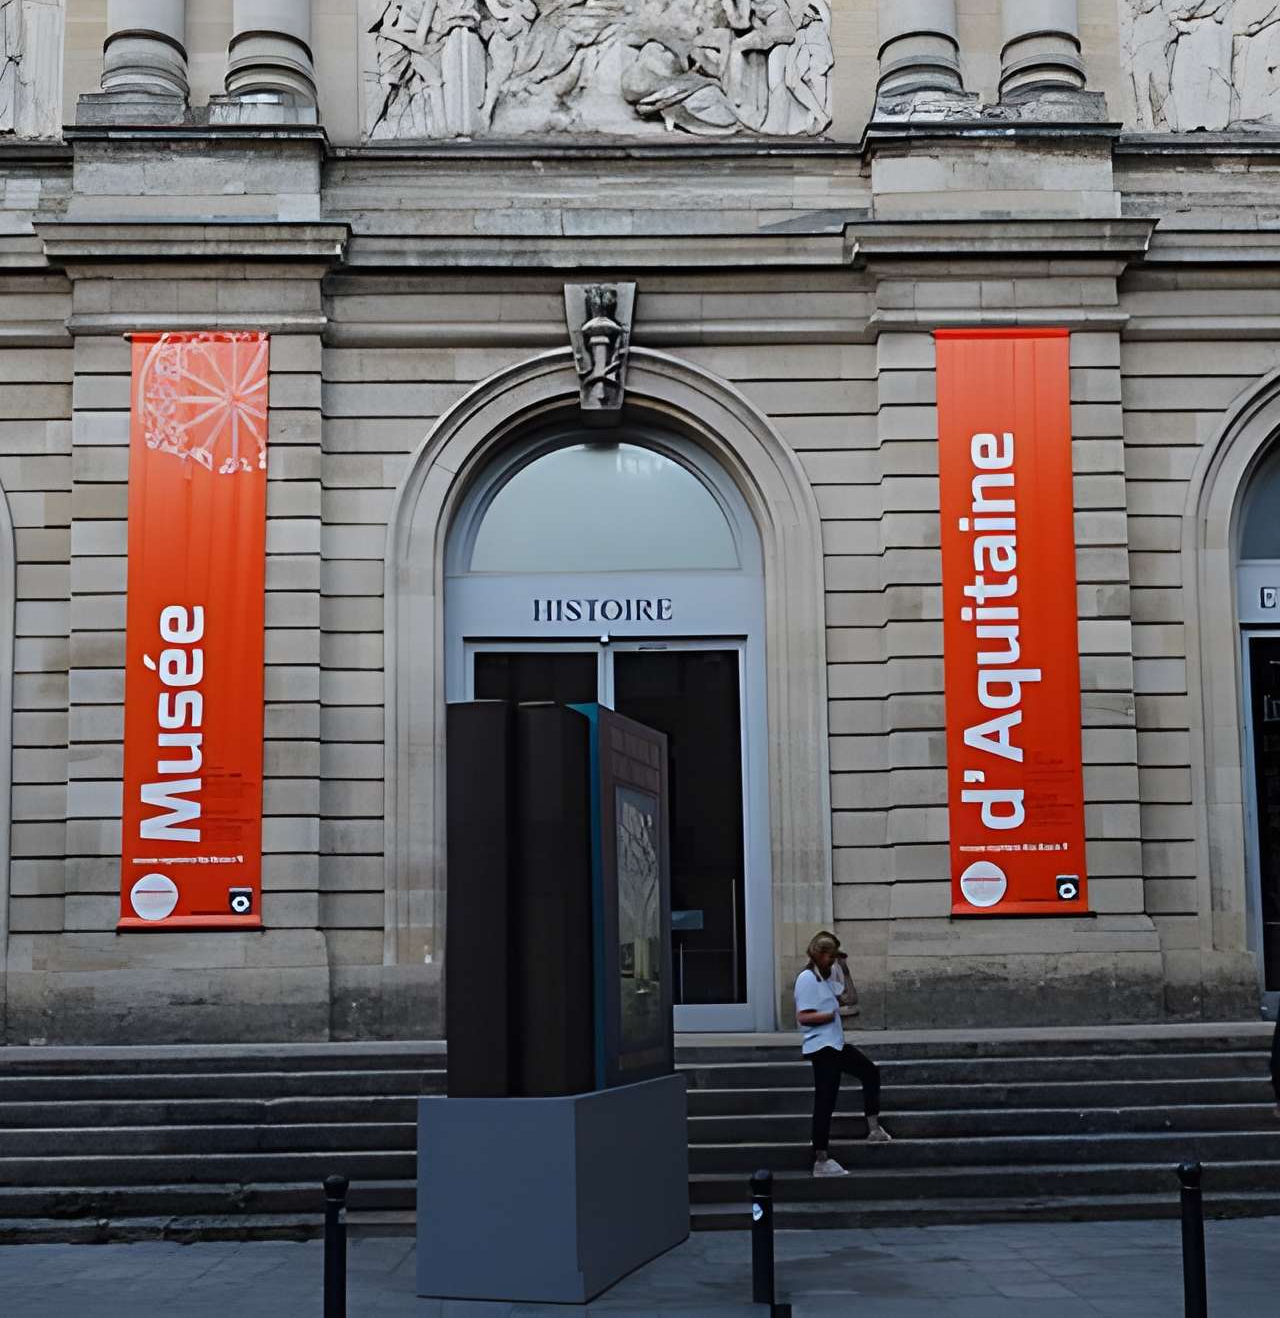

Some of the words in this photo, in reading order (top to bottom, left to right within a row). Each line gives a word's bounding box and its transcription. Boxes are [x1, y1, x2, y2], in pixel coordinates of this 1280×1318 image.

[140, 604, 205, 844] Musée
[532, 598, 673, 622] HISTOIRE
[959, 431, 1042, 831] d'Aquitaine
